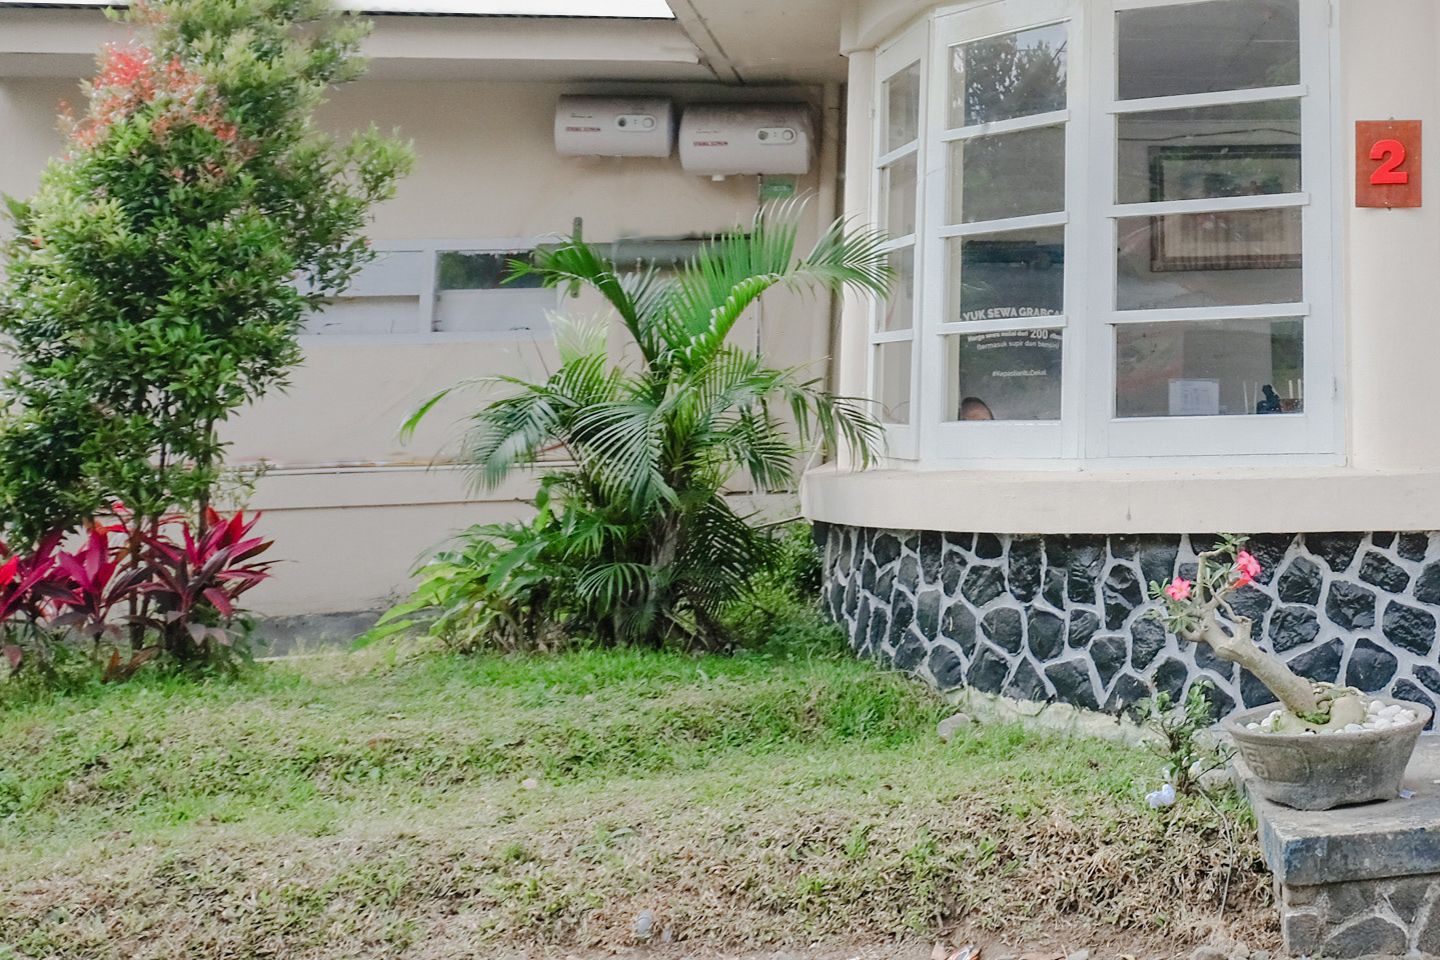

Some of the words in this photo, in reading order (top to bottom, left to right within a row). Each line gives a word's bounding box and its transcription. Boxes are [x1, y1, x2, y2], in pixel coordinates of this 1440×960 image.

[1369, 139, 1408, 185] 2
[963, 310, 986, 321] YUK
[987, 307, 1018, 319] SEWA
[1030, 329, 1049, 339] 200
